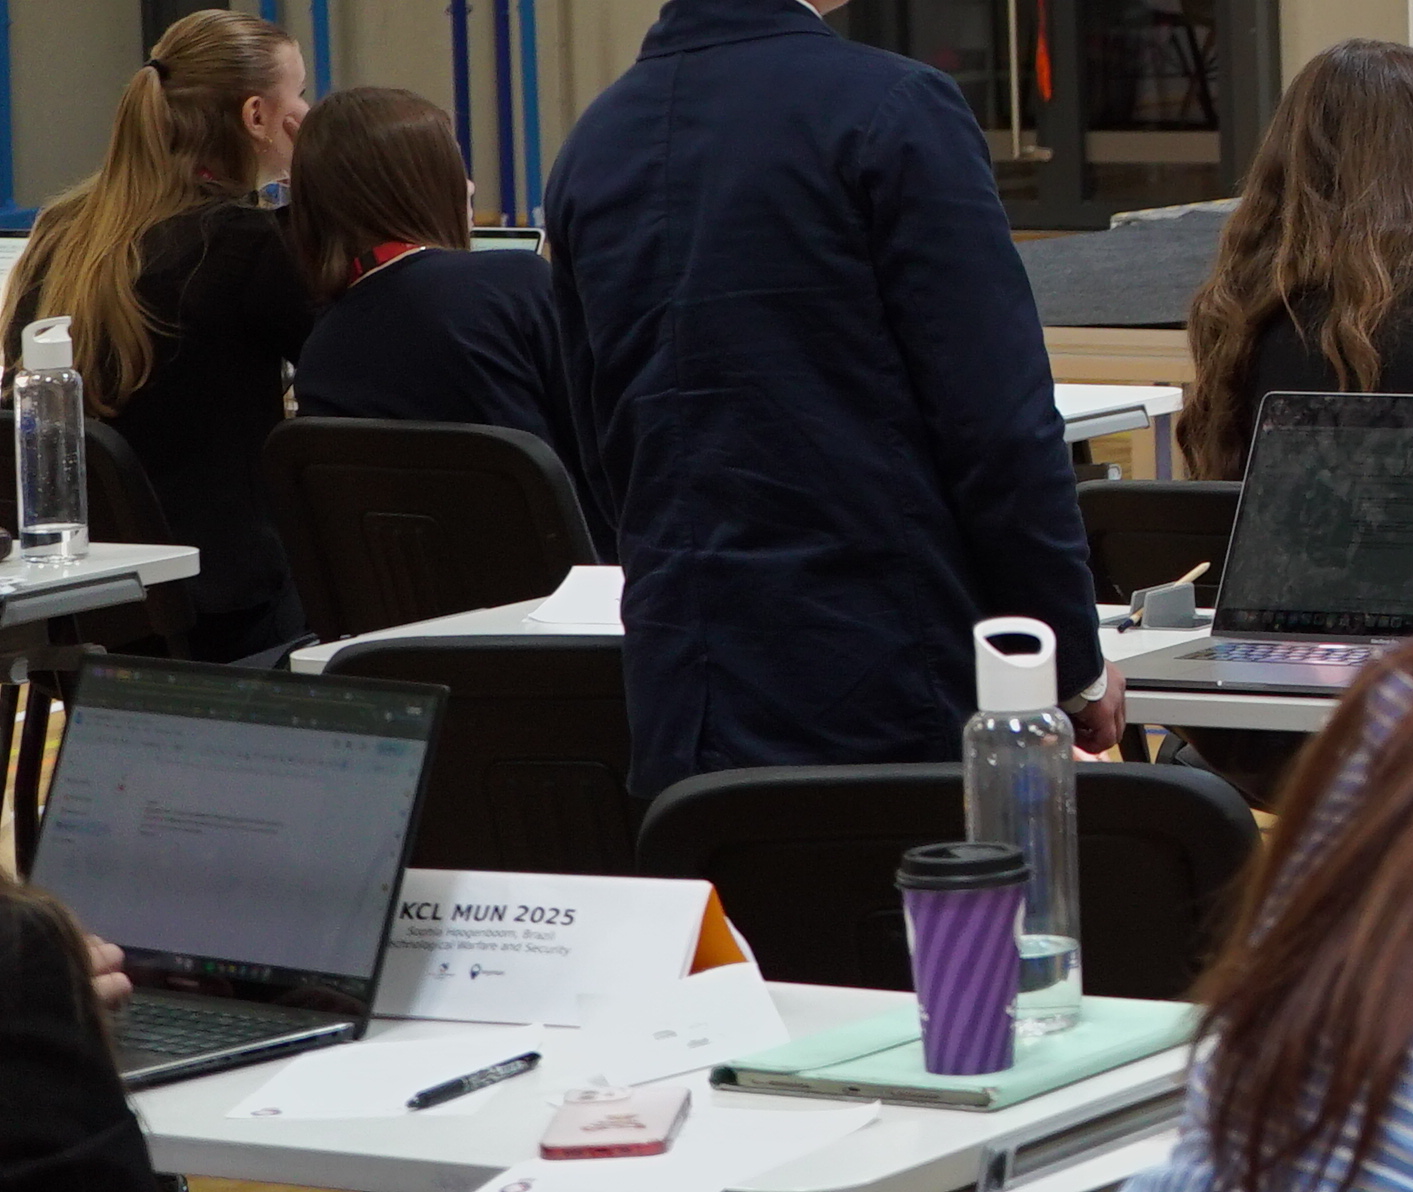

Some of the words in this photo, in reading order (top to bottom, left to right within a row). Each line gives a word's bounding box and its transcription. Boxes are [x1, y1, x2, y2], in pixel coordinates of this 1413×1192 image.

[399, 901, 442, 921] KCL
[451, 903, 506, 923] MUN
[514, 905, 576, 927] 2025
